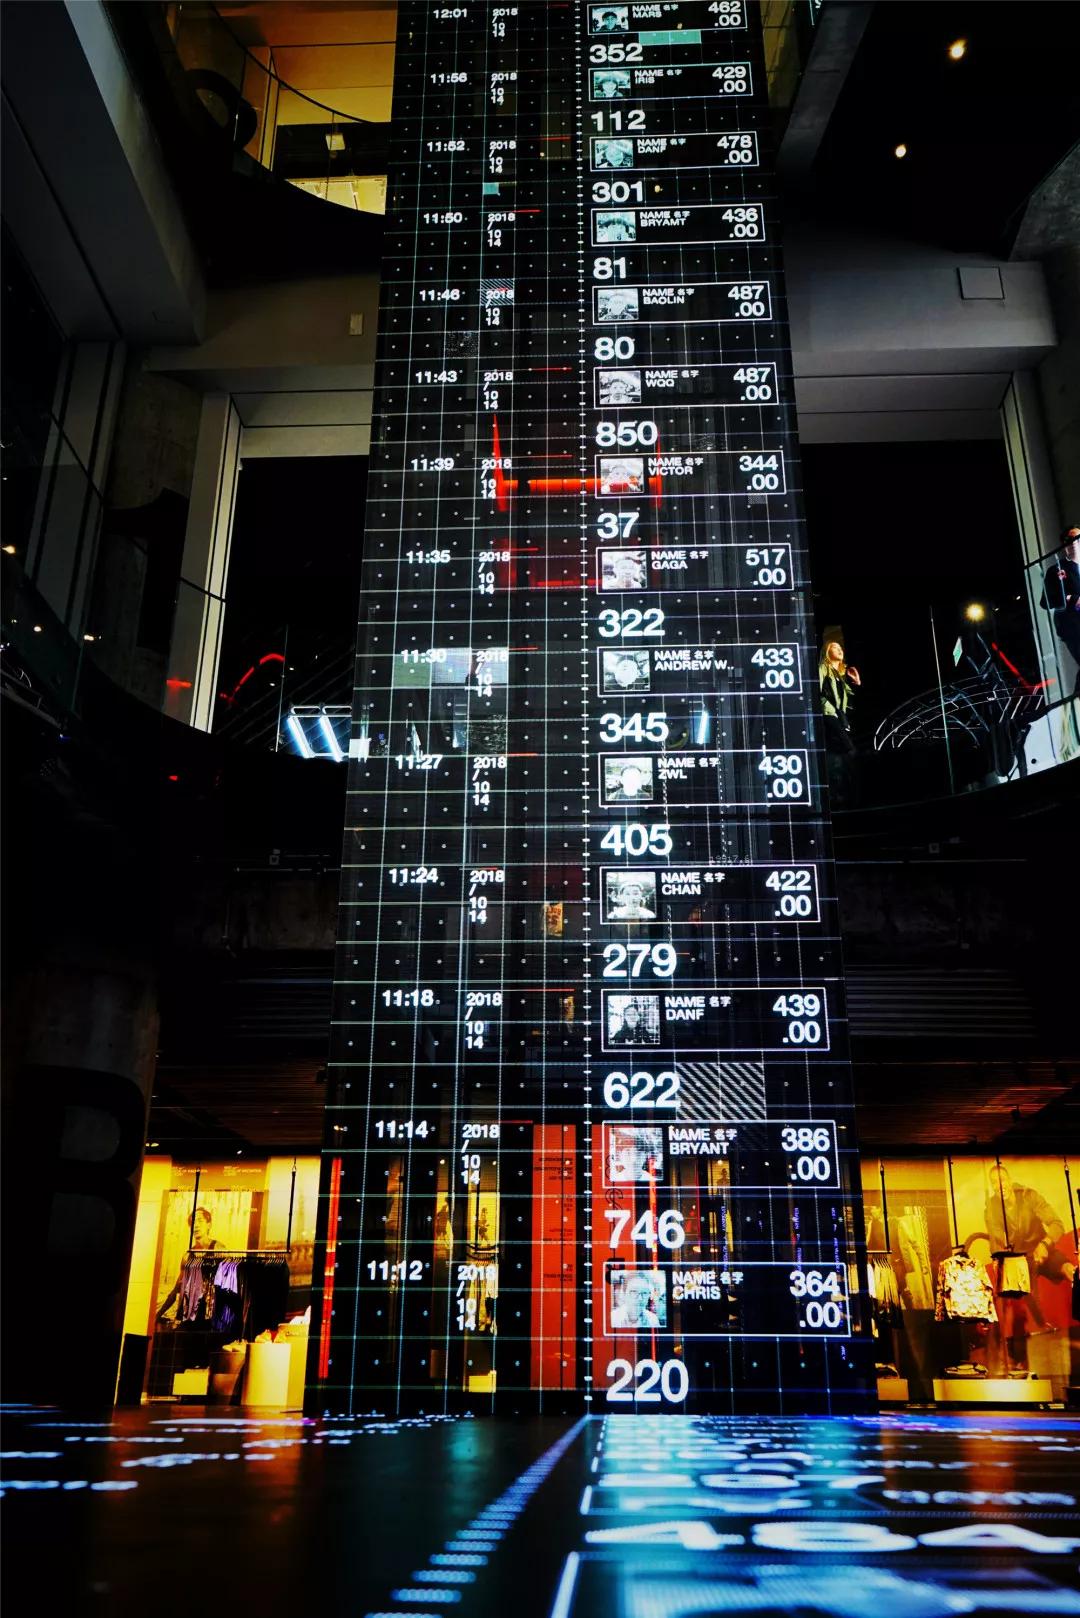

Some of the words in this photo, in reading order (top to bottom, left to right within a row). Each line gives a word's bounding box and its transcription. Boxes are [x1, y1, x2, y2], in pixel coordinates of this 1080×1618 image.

[493, 8, 518, 16] 2018
[708, 1, 741, 13] 462
[433, 9, 467, 19] 12:01
[714, 15, 741, 26] .00
[589, 43, 643, 63] 352
[430, 72, 467, 83] 11:56
[491, 73, 517, 81] 2018
[635, 69, 663, 77] NAME
[712, 66, 746, 79] 429
[719, 80, 746, 93] .00
[491, 96, 504, 104] 14
[591, 111, 646, 131] 112
[427, 141, 465, 152] 11:52
[490, 141, 516, 150] 2018
[717, 135, 752, 148] 478
[489, 157, 503, 165] 10
[724, 150, 752, 164] .00
[489, 165, 502, 173] 14
[592, 181, 644, 203] 301
[424, 212, 462, 223] 11:50
[488, 213, 515, 222] 2018
[640, 211, 670, 219] NAME
[722, 208, 758, 222] 436
[488, 230, 501, 238] 10
[730, 224, 758, 238] .00
[488, 239, 501, 247] 14
[593, 257, 626, 279] 81
[420, 289, 460, 301] 11:46
[486, 290, 513, 299] 2018
[728, 286, 764, 300] 487
[643, 296, 685, 304] BAOLIN
[486, 308, 500, 317] 10
[735, 302, 765, 317] .00
[486, 317, 500, 325] 14
[594, 337, 635, 361] 80
[415, 370, 457, 383] 11:43
[484, 372, 513, 381] 2018
[645, 370, 678, 378] NAME
[733, 368, 771, 383] 487
[484, 391, 498, 400] 10
[741, 385, 771, 401] .00
[484, 401, 498, 409] 14
[596, 421, 658, 446] 850
[411, 458, 454, 471] 11:39
[481, 459, 512, 468] 2018
[648, 458, 682, 466] NAME
[739, 455, 778, 471] 344
[649, 467, 693, 475] VICTOR
[481, 479, 496, 489] 10
[747, 474, 778, 490] .00
[481, 489, 496, 499] 14
[597, 512, 639, 539] 37
[406, 550, 450, 563] 11:35
[479, 552, 510, 561] 2018
[651, 551, 686, 560] NAME
[746, 549, 785, 565] 517
[652, 560, 688, 569] GAGA
[479, 573, 494, 583] 10
[753, 568, 786, 585] .00
[479, 584, 494, 594] 14
[599, 609, 665, 637] 322
[401, 649, 446, 662] 11:30
[476, 651, 508, 662] 2018
[655, 650, 690, 660] NAME
[751, 649, 794, 666] 433
[655, 661, 711, 670] ANDREW
[476, 674, 492, 685] 10
[760, 670, 794, 688] .00
[477, 686, 492, 696] 14
[600, 713, 668, 742] 345
[395, 755, 443, 769] 11:27
[473, 757, 507, 768] 2018
[658, 758, 695, 768] NAME
[759, 755, 802, 775] 430
[658, 769, 687, 779] ZWL
[473, 782, 490, 793] 10
[767, 778, 802, 797] .00
[473, 795, 490, 805] 14
[600, 825, 673, 855] 405
[389, 868, 438, 883] 11:24
[470, 870, 505, 882] 2018
[661, 872, 700, 883] NAME
[766, 871, 811, 891] 422
[662, 884, 701, 895] CHAN
[469, 897, 487, 908] 10
[775, 895, 811, 916] .00
[469, 911, 487, 922] 14
[603, 943, 677, 978] 279
[382, 990, 434, 1006] 11:18
[466, 993, 502, 1005] 2018
[665, 996, 705, 1008] NAME
[773, 994, 820, 1017] 439
[466, 1021, 484, 1034] 10
[782, 1021, 820, 1043] .00
[466, 1036, 484, 1048] 14
[603, 1072, 681, 1109] 622
[375, 1120, 428, 1138] 11:14
[462, 1125, 500, 1138] 2018
[669, 1128, 711, 1140] NAME
[781, 1127, 830, 1152] 386
[670, 1142, 729, 1155] BRYANT
[462, 1155, 480, 1169] 10
[791, 1157, 830, 1180] .00
[461, 1171, 480, 1184] 14
[604, 1210, 686, 1248] 746
[367, 1261, 422, 1280] 11:12
[458, 1266, 497, 1280] 2018
[672, 1271, 716, 1285] NAME
[790, 1271, 840, 1297] 364
[672, 1286, 721, 1300] CHRIS
[457, 1299, 476, 1313] 10
[799, 1302, 841, 1328] .00
[457, 1316, 476, 1330] 14
[607, 1360, 689, 1402] 220
